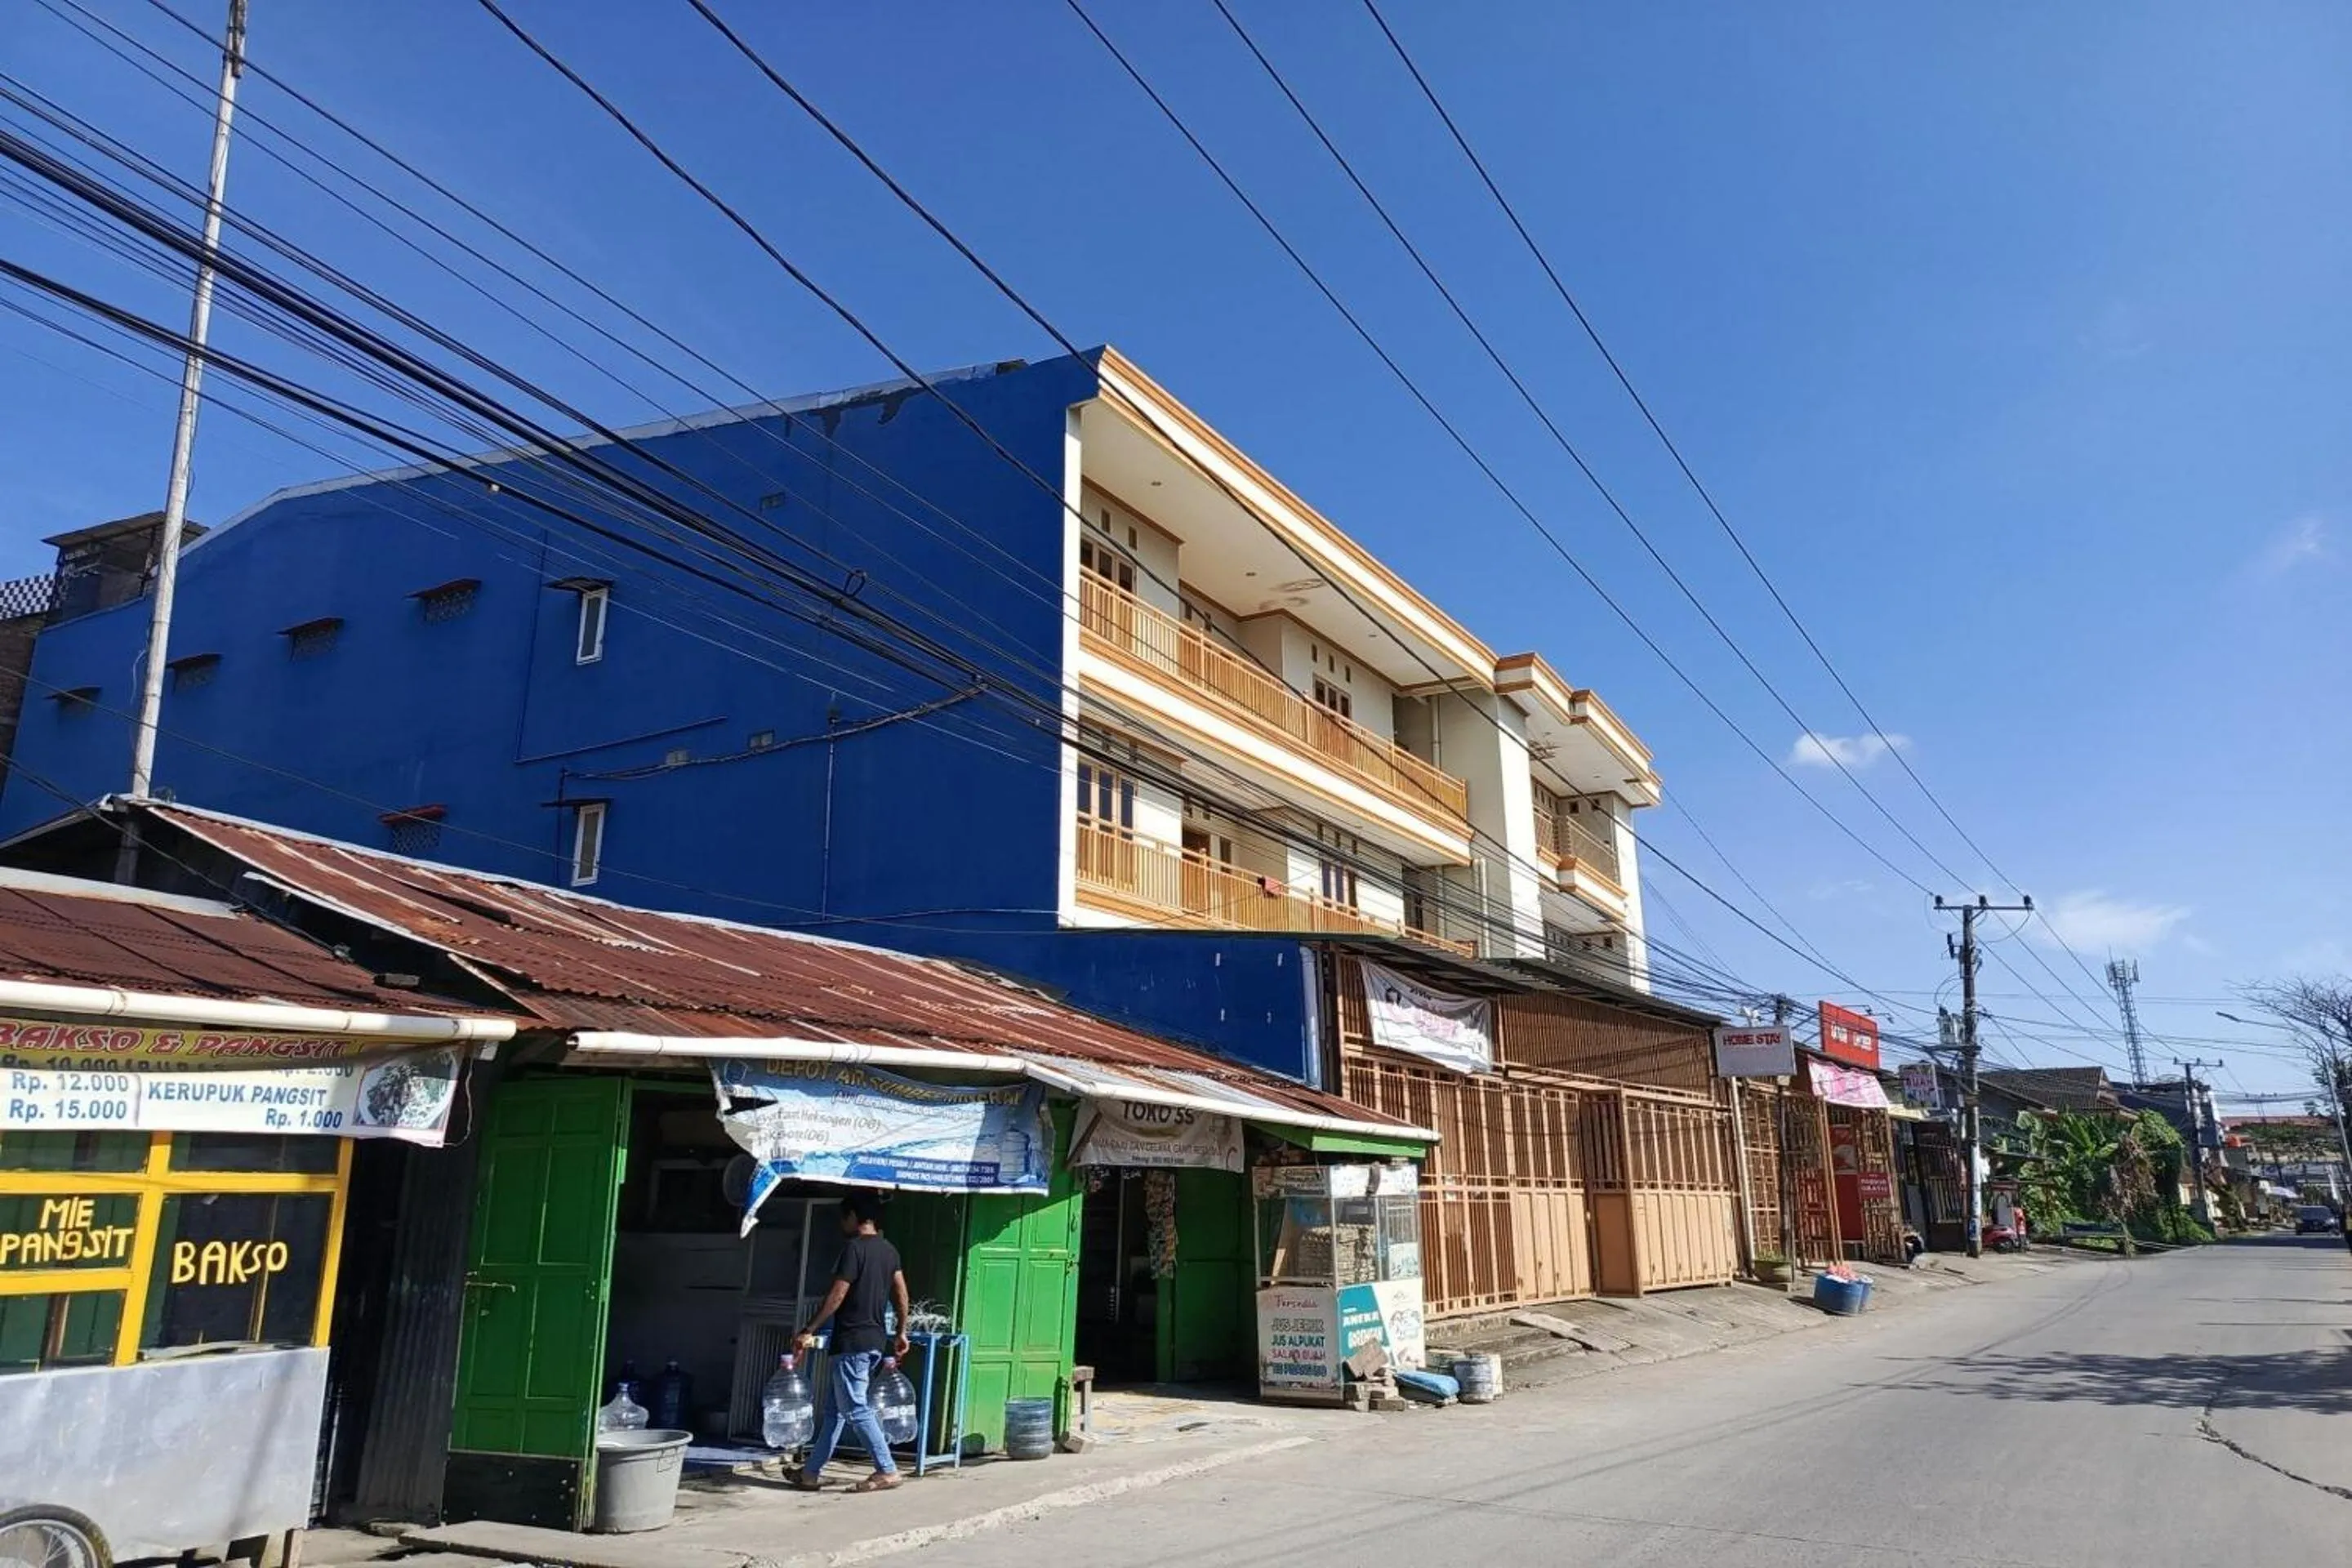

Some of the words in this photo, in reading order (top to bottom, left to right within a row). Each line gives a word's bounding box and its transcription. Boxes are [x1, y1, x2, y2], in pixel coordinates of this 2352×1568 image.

[0, 1022, 142, 1053] BAKSO
[148, 1032, 185, 1055] &
[189, 1032, 350, 1058] PANGSIT
[1722, 1033, 1754, 1045] HOME
[1756, 1031, 1782, 1045] STAY
[766, 1058, 832, 1080] DEPOT
[12, 1071, 47, 1094] Rp.
[56, 1073, 129, 1092] 12.000
[148, 1080, 245, 1102] KERUPUK
[251, 1085, 327, 1106] PANGSIT
[9, 1098, 45, 1123] Rp.
[55, 1099, 127, 1120] 15.000
[265, 1107, 291, 1129] Rp.
[300, 1110, 343, 1129] 1.000
[1121, 1101, 1172, 1124] TOKO
[39, 1196, 95, 1229] MIE
[172, 1241, 287, 1285] BAKSO
[1272, 1334, 1287, 1347] JUS
[1288, 1335, 1325, 1348] ALPUKAT
